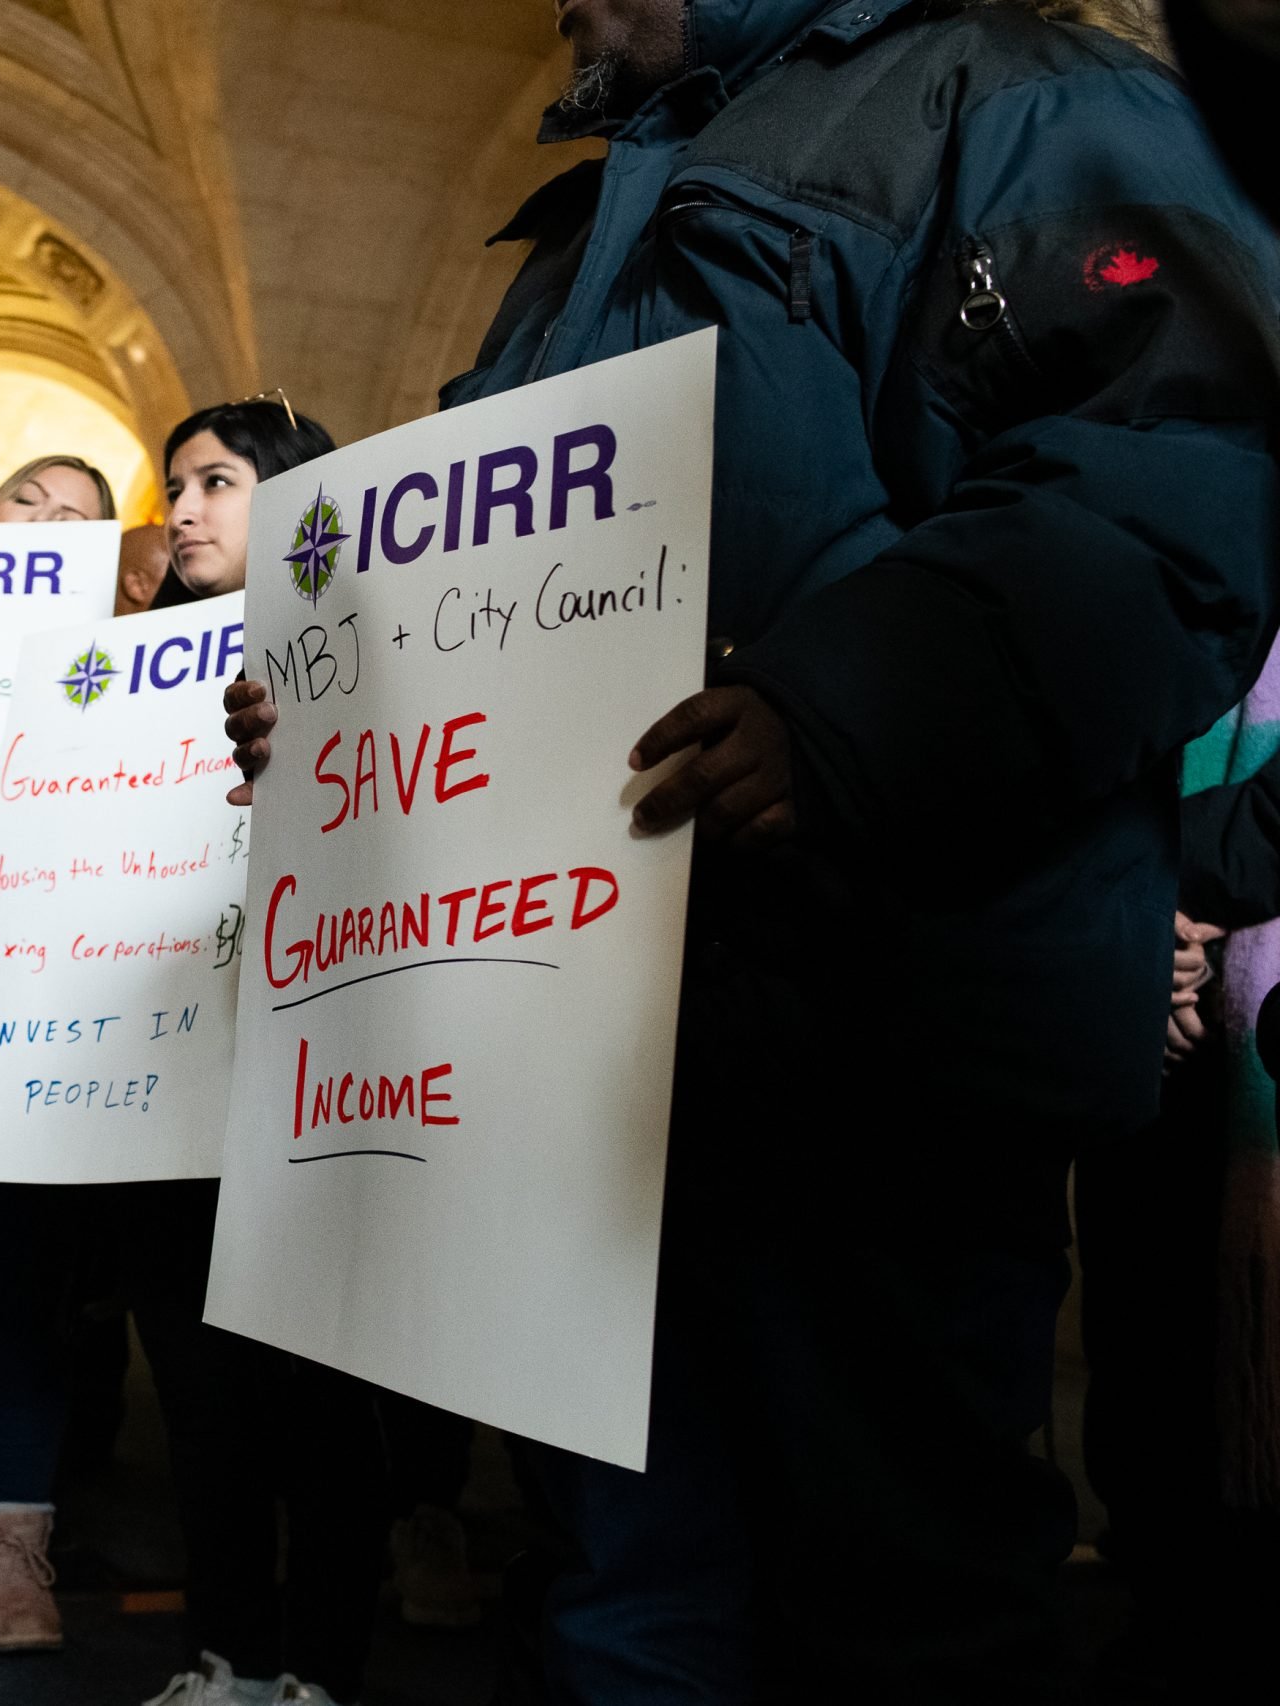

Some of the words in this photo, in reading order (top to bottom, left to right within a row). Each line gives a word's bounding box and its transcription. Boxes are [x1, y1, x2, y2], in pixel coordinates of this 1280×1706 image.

[356, 424, 618, 573] ICIRR
[128, 622, 244, 694] ICIR
[264, 613, 359, 704] MBJ
[392, 624, 410, 650] +
[433, 587, 518, 653] City
[535, 545, 687, 630] Council:
[0, 733, 165, 802] Guaranteed
[174, 738, 237, 784] Incom
[314, 711, 490, 833] SAVE
[69, 857, 104, 880] the
[149, 1003, 199, 1042] IN
[24, 1074, 160, 1114] PEOPLE!
